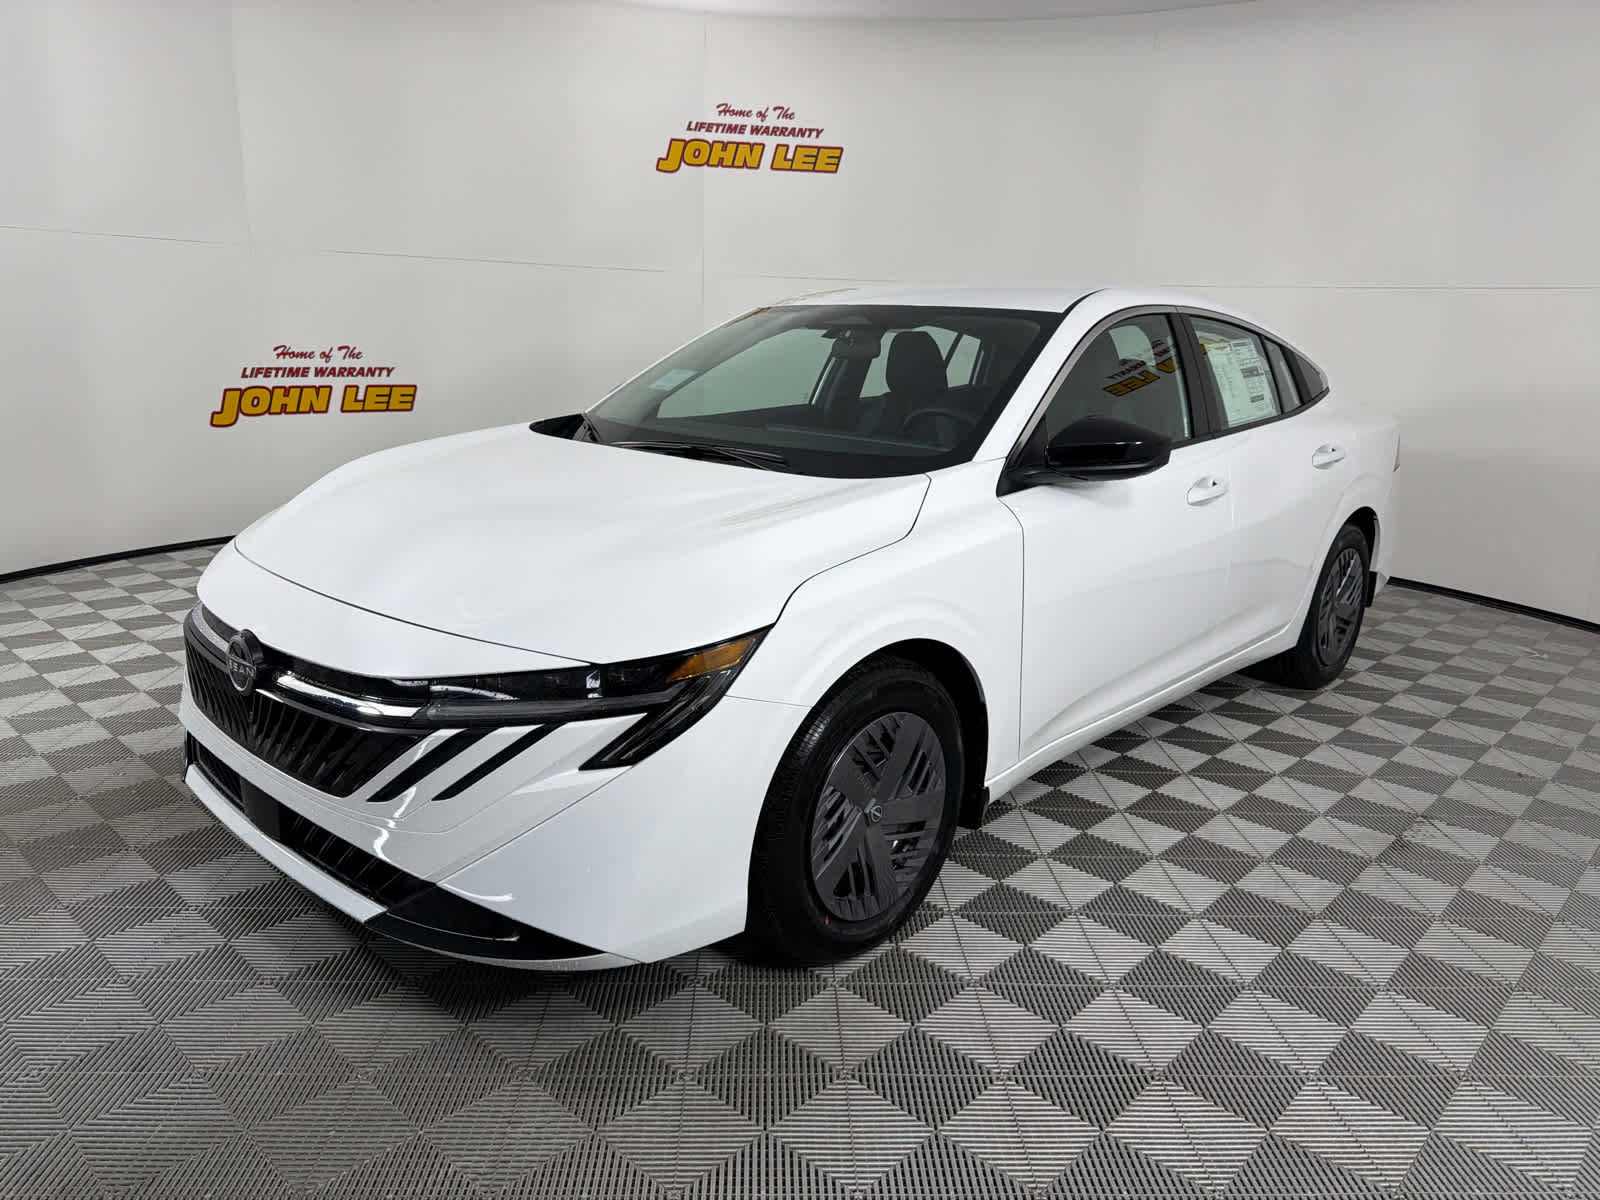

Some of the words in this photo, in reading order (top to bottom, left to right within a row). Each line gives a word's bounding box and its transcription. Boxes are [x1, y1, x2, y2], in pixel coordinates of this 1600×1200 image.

[716, 103, 753, 118] Home
[756, 107, 769, 122] of
[772, 106, 796, 120] The
[686, 121, 746, 134] LIFETIME
[750, 125, 824, 139] WARRANTY
[656, 138, 765, 173] JOHN
[771, 144, 844, 173] LEE
[273, 345, 315, 360] Home
[319, 347, 334, 363] of
[337, 345, 363, 360] The
[241, 366, 310, 378] LIFETIME
[314, 366, 395, 378] WARRANTY
[210, 385, 332, 428] JOHN
[341, 384, 417, 413] LEE
